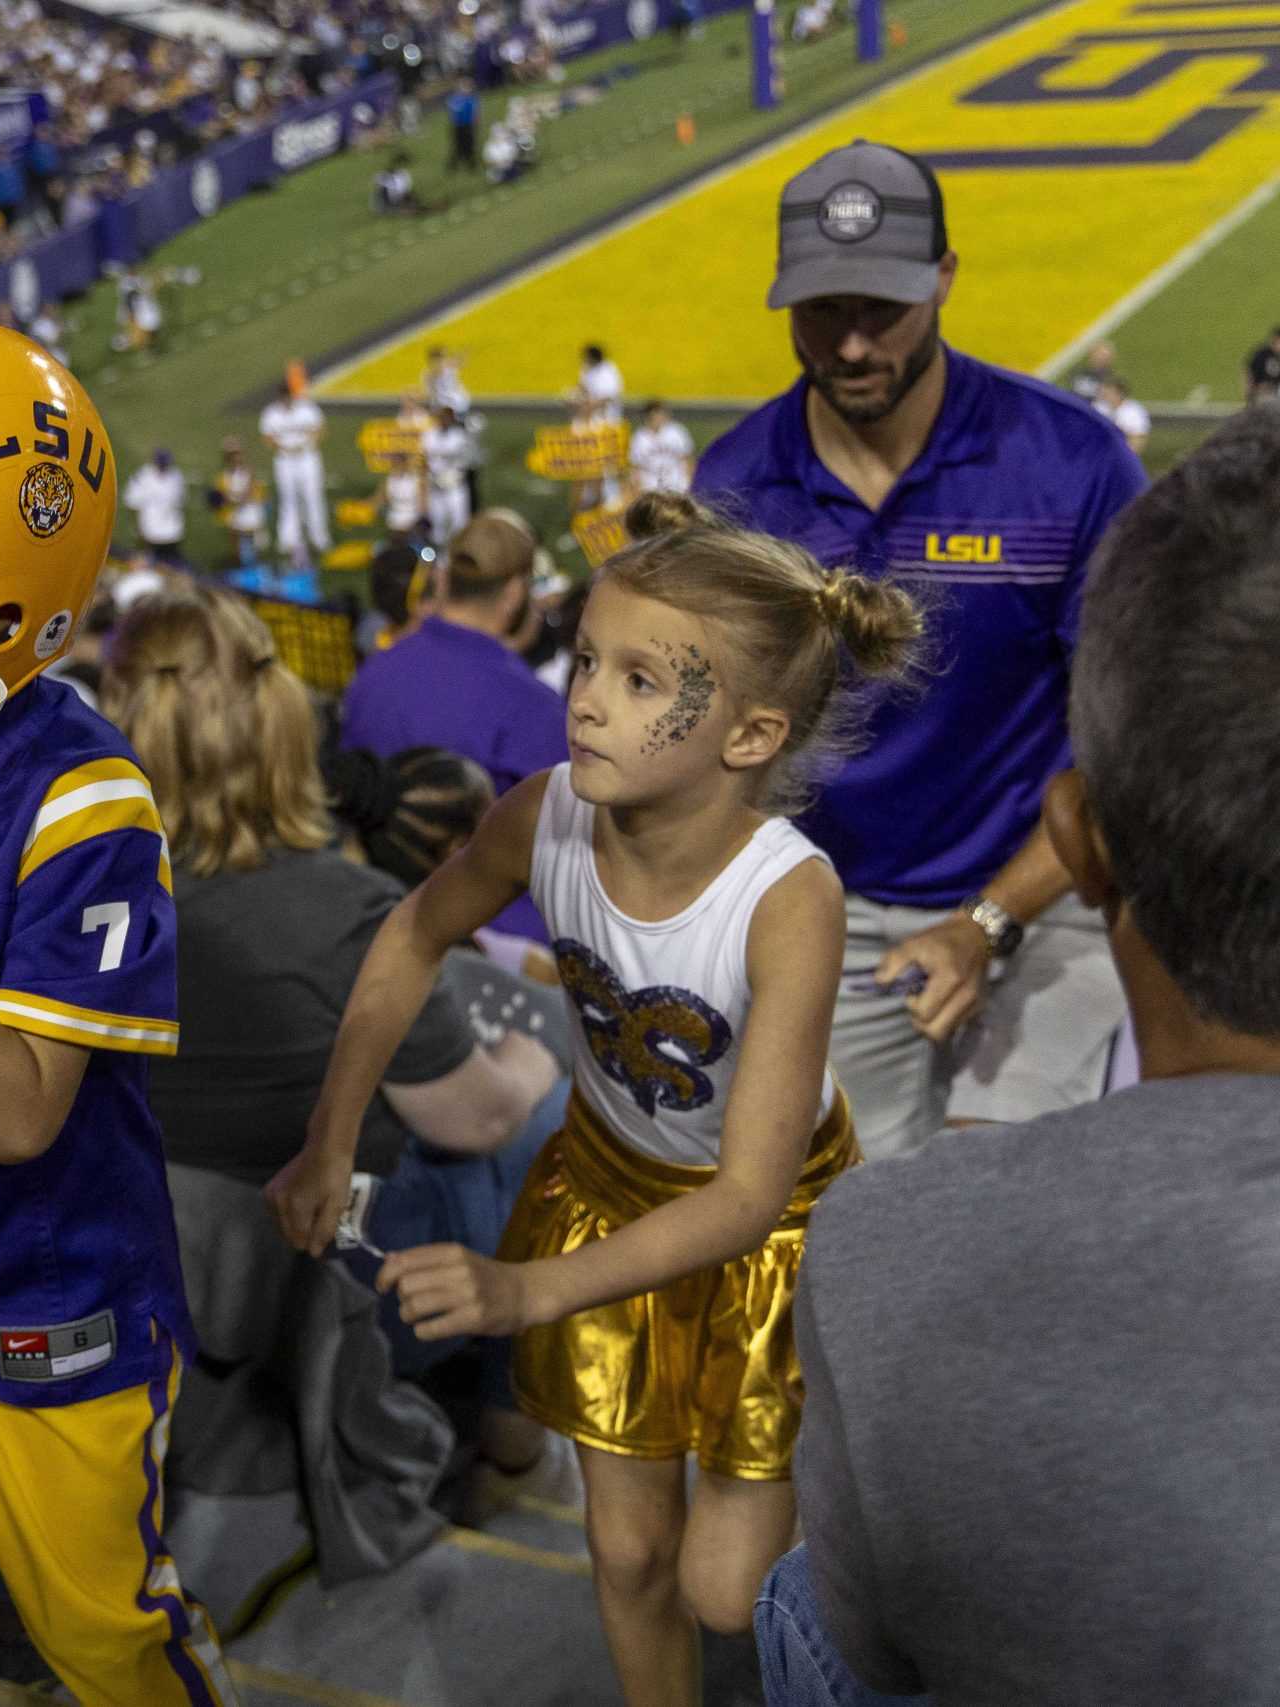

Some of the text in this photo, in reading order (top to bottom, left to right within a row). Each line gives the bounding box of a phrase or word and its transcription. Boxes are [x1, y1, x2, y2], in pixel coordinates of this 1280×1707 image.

[925, 533, 1002, 563] LSU
[81, 901, 131, 973] 7
[6, 1351, 46, 1360] TEAM
